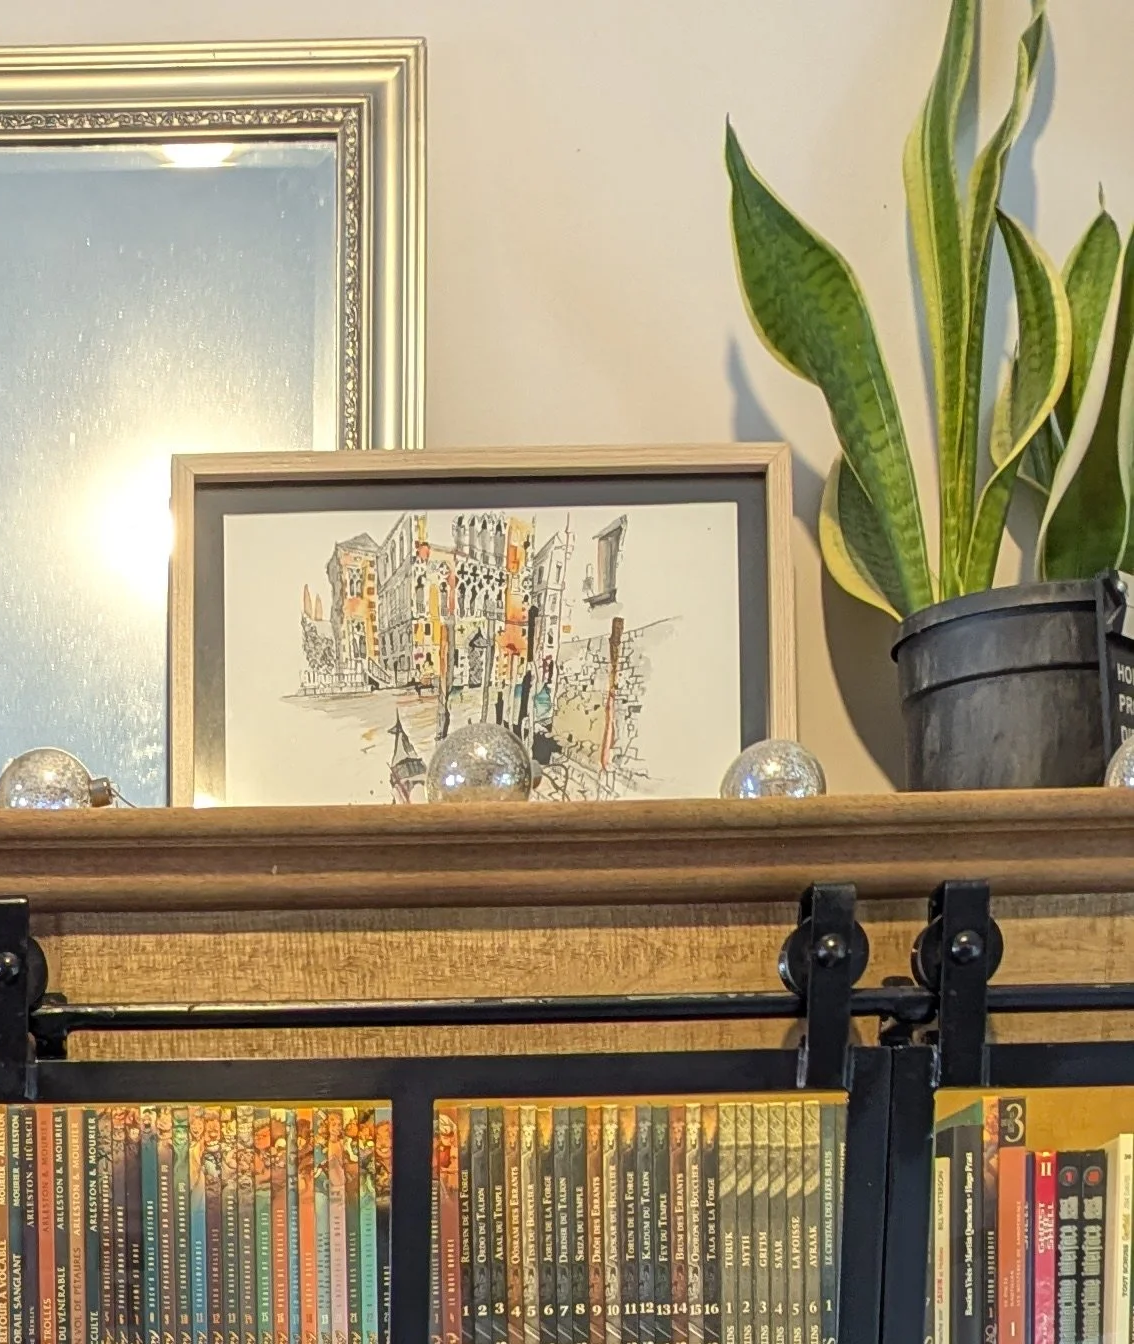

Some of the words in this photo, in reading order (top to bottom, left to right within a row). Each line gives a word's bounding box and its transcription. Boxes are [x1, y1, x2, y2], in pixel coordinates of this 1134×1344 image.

[1005, 1103, 1024, 1142] 3
[55, 1116, 63, 1162] MOURIER
[71, 1122, 80, 1168] MOURIER
[88, 1118, 96, 1164] MOURIER
[26, 1172, 34, 1227] ARLESTON
[56, 1179, 64, 1229] ARLESTON
[41, 1181, 49, 1233] ARLESTON
[72, 1185, 81, 1236] ARLESTON
[89, 1181, 97, 1232] ARLESTON
[12, 1254, 21, 1308] SANGLANT
[463, 1305, 469, 1316] 1
[478, 1304, 487, 1316] 2
[495, 1302, 504, 1314] 3
[511, 1305, 521, 1318] 4
[528, 1305, 536, 1318] 5
[544, 1304, 553, 1316] 6
[560, 1305, 569, 1316] 7
[577, 1303, 585, 1314] 8
[593, 1305, 601, 1316] 9
[607, 1304, 619, 1316] 10
[625, 1303, 637, 1315] 11
[640, 1302, 654, 1314] 12
[657, 1303, 671, 1315] 13
[673, 1303, 687, 1314] 14
[689, 1304, 702, 1316] 15
[705, 1303, 719, 1314] 16
[0, 1303, 7, 1343] RETOUR
[43, 1299, 52, 1339] TROLLES
